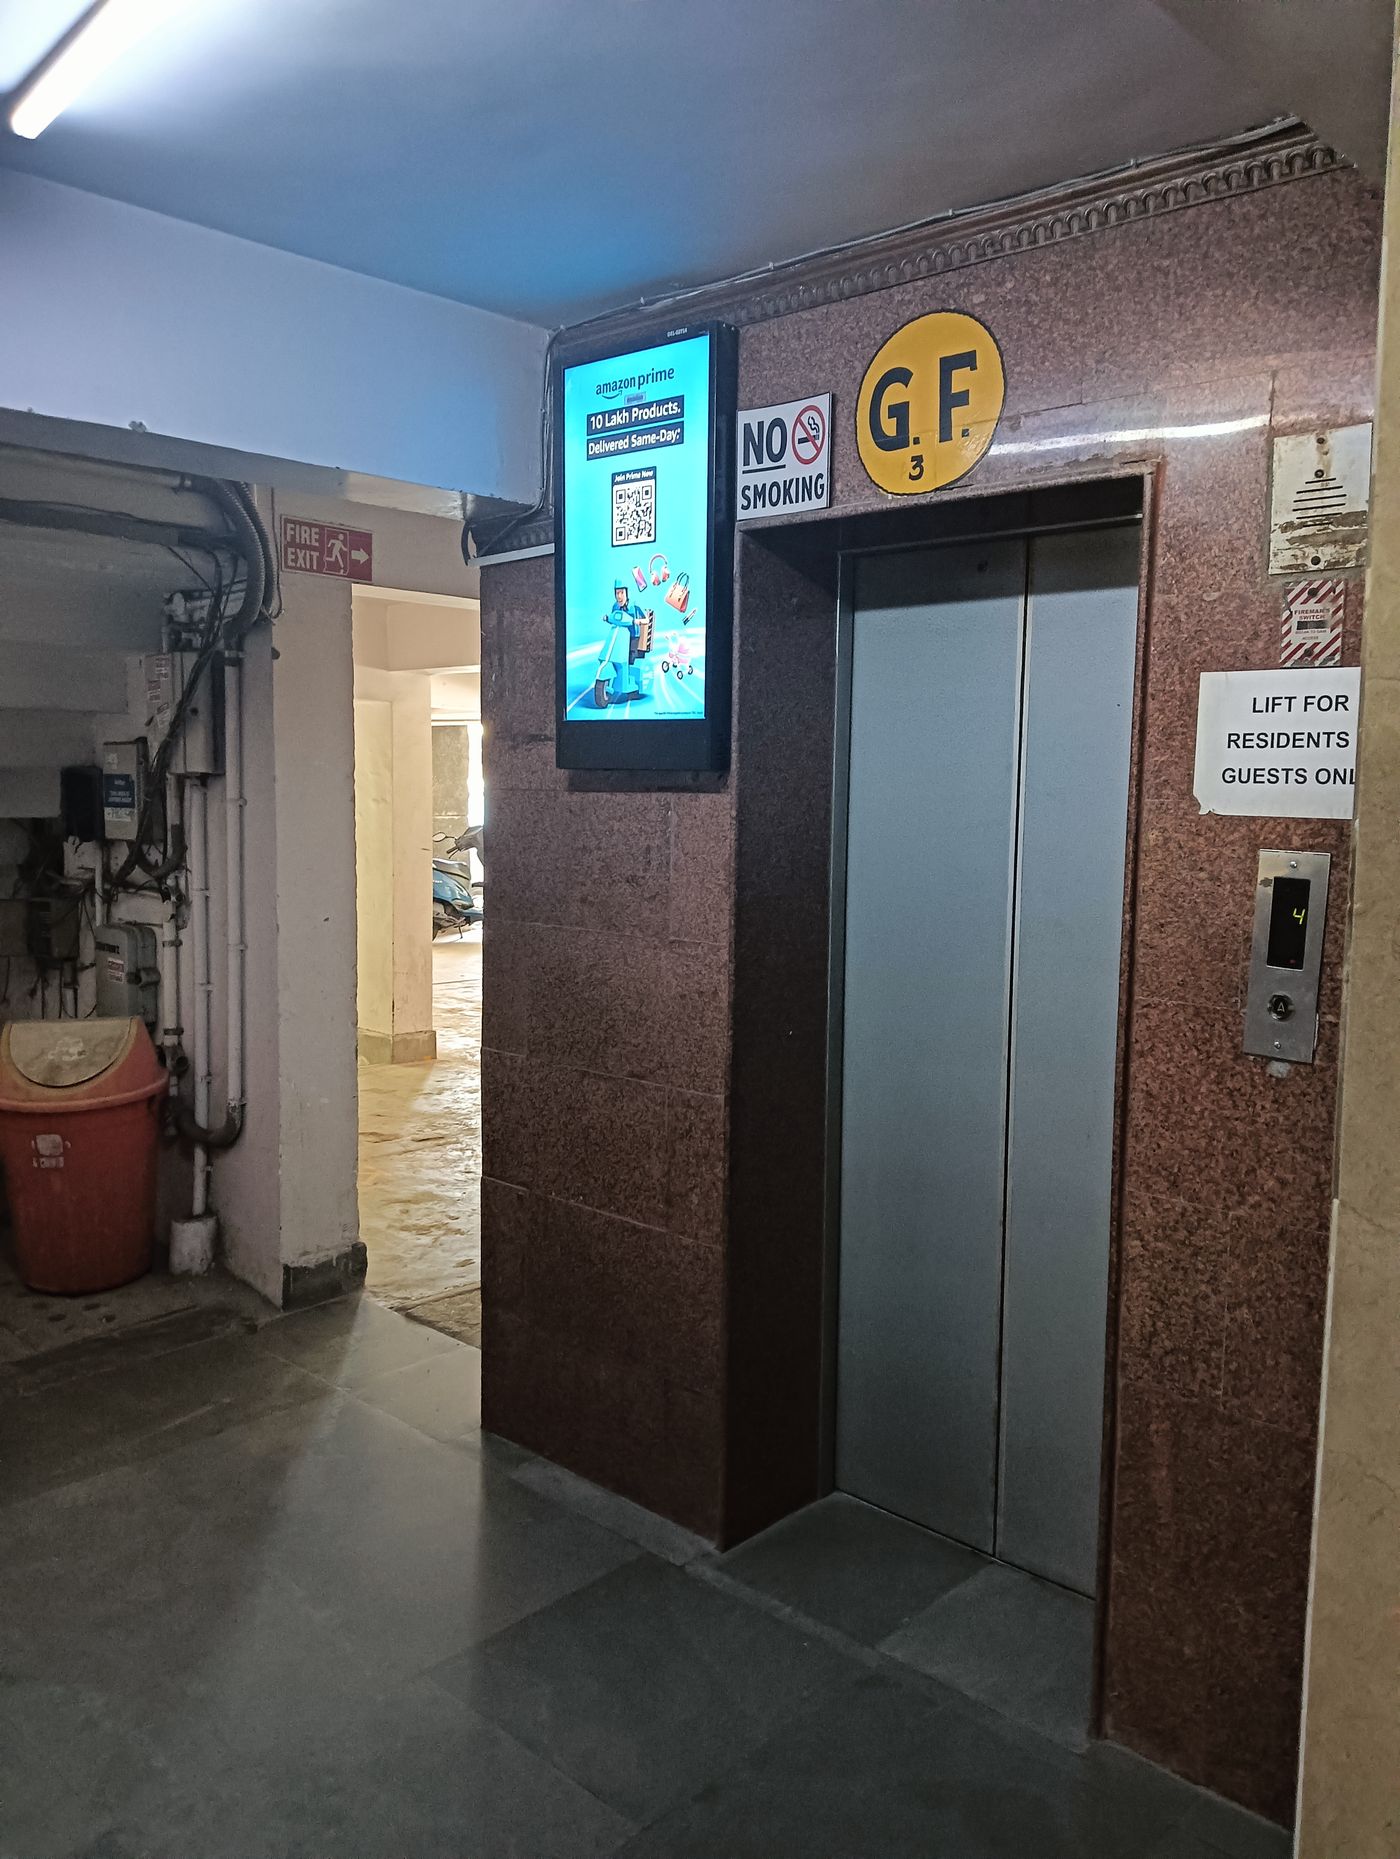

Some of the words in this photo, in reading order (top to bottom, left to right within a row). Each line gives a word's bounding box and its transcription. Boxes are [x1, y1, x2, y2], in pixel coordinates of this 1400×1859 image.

[595, 375, 636, 395] amazon
[637, 367, 675, 390] prime
[590, 414, 603, 430] 10
[605, 409, 629, 427] Lakh
[588, 435, 629, 455] Delivered
[742, 417, 788, 467] NO
[614, 473, 626, 482] Join
[626, 472, 641, 480] Prime
[908, 454, 924, 481] 3
[740, 472, 825, 511] SMOKING
[286, 523, 320, 547] FIRE
[287, 547, 320, 570] EXIT
[1252, 696, 1297, 713] LIFT
[1303, 694, 1349, 712] FOR
[1227, 731, 1350, 749] RESIDENTS
[1221, 767, 1308, 785] GUESTS
[1292, 907, 1306, 925] 4
